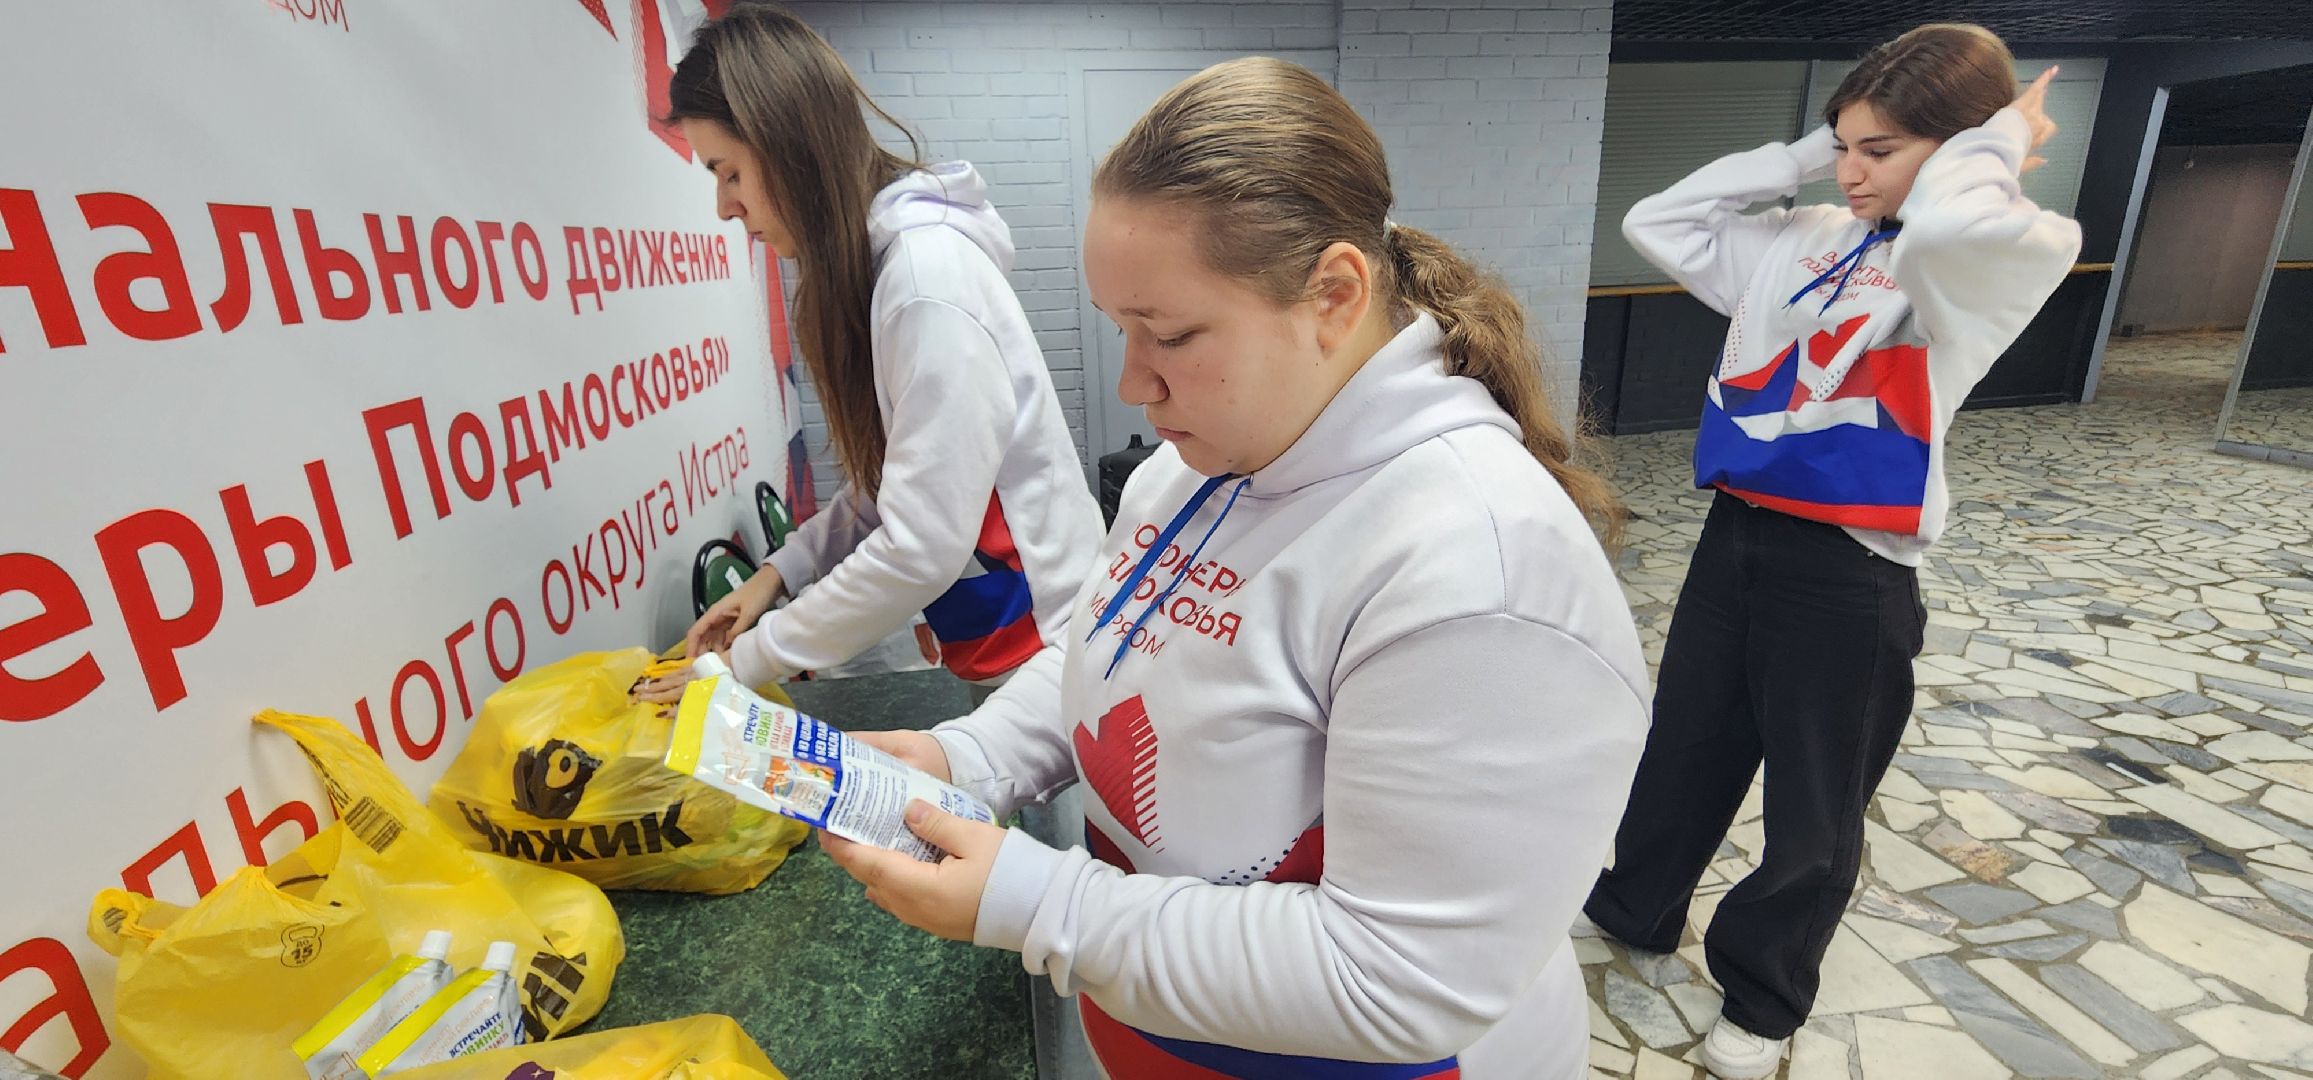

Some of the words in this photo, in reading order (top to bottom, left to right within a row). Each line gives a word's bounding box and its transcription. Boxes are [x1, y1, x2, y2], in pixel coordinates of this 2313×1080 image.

[0, 188, 549, 353] нального
[563, 226, 730, 315] движения
[362, 335, 730, 540] Подмосковья»
[541, 479, 679, 636] округа
[678, 425, 750, 518] Истра
[456, 799, 694, 864] ЧИЖИК
